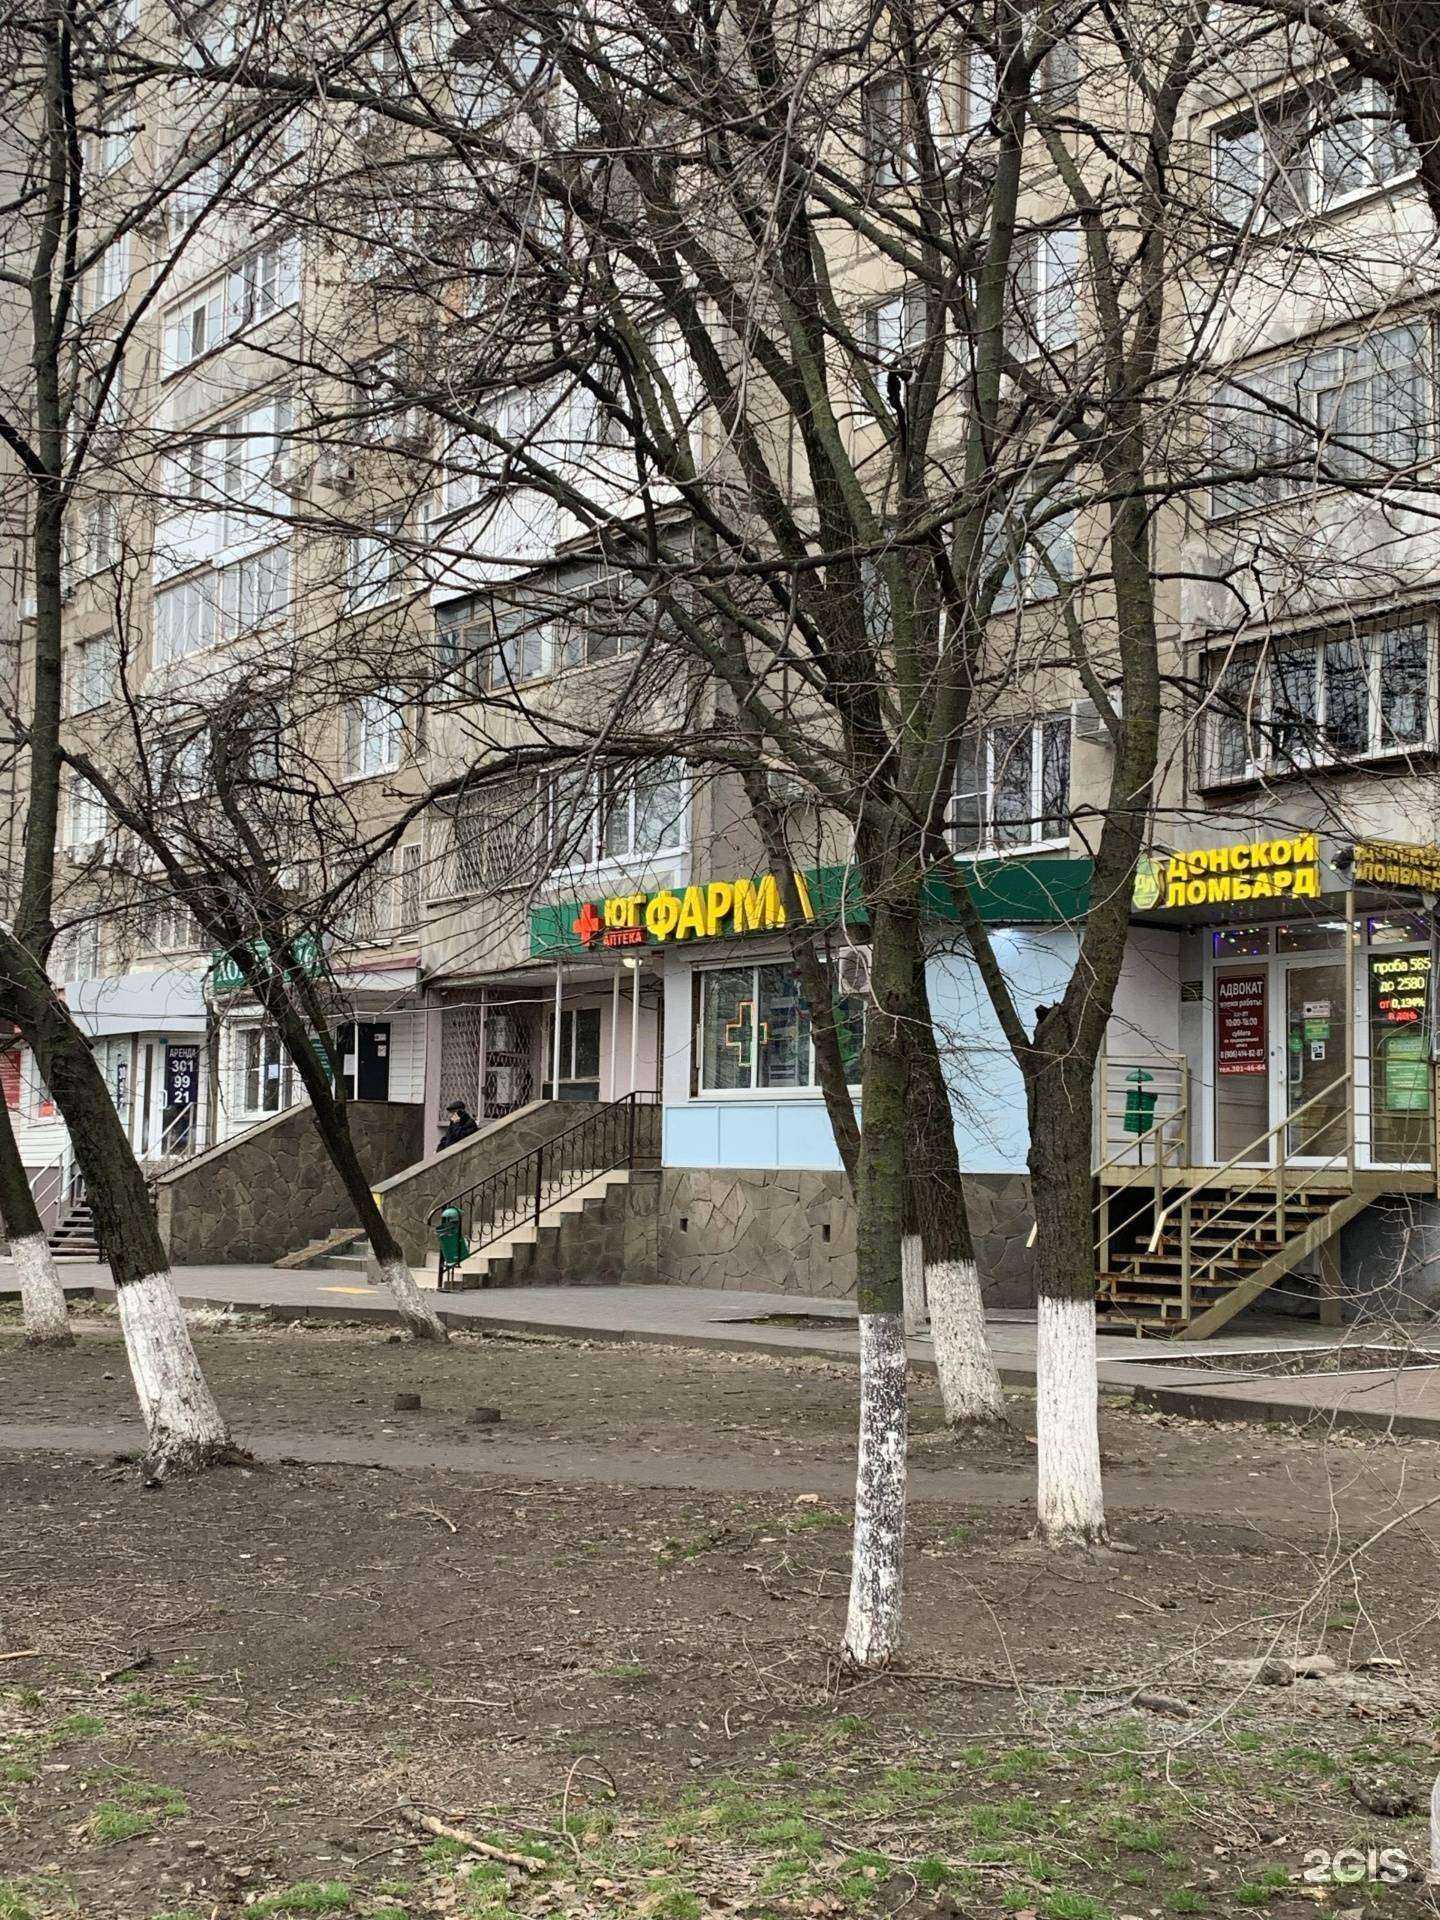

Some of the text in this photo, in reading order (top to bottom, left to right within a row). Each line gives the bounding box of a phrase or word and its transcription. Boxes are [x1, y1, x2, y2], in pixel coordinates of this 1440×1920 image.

[1167, 833, 1319, 881] ДОНСКОЙ
[1166, 868, 1320, 908] ЛОМБАРД
[604, 892, 646, 927] ЮГ
[603, 931, 642, 946] АПТЕКА
[1373, 958, 1408, 975] проба
[1220, 981, 1263, 997] АДВОКАТ
[1379, 976, 1425, 993] до 2580
[1379, 1000, 1391, 1009] от
[172, 1059, 194, 1072] 301
[173, 1075, 191, 1088] 99
[174, 1091, 190, 1103] 21
